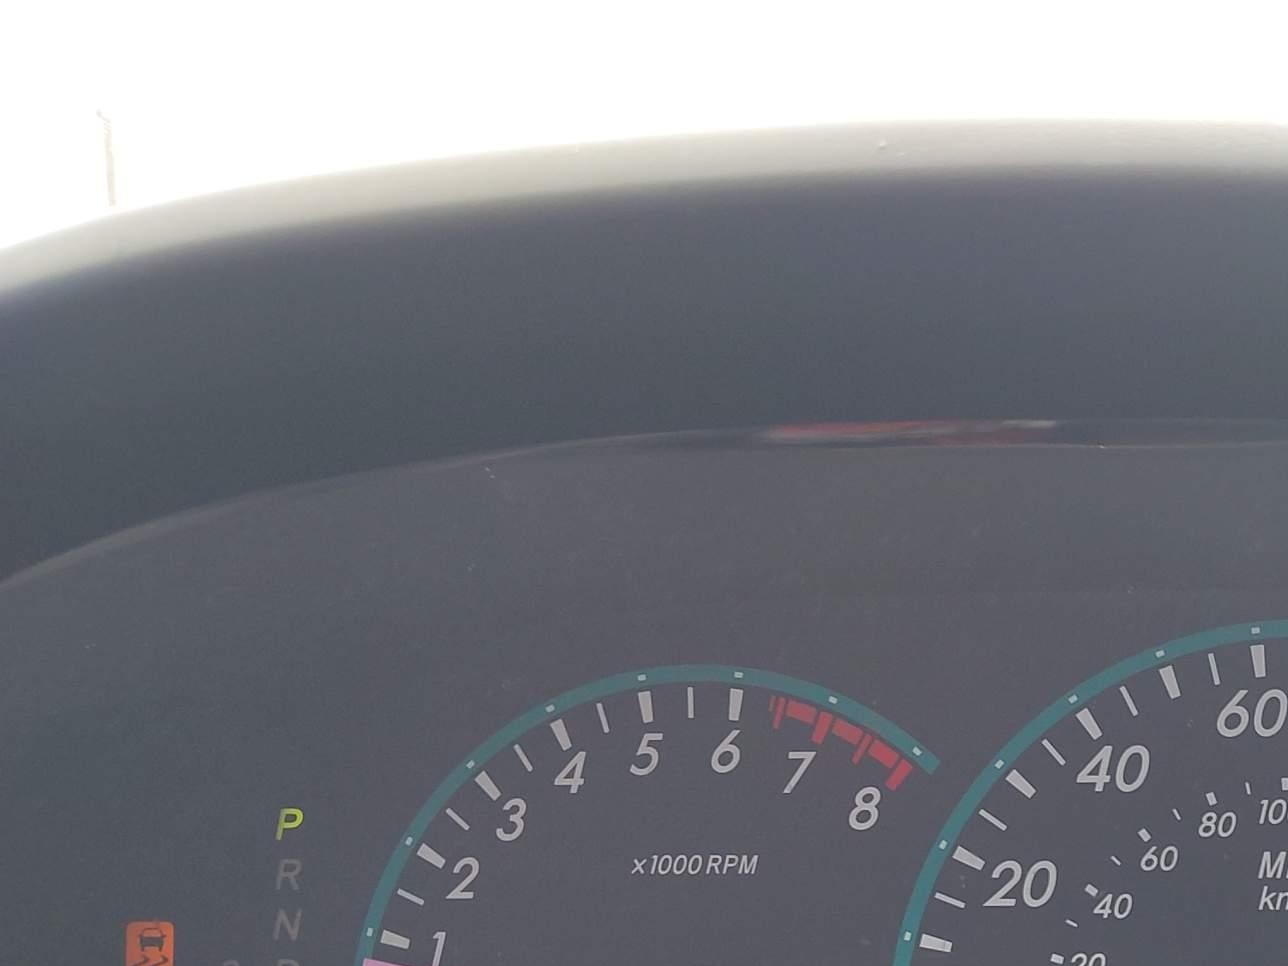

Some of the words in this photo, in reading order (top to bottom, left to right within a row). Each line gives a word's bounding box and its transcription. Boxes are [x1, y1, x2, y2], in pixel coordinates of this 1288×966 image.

[1216, 688, 1288, 738] 60
[554, 751, 586, 793] 4
[629, 732, 663, 776] 5
[710, 729, 741, 773] 6
[782, 751, 817, 794] 7
[1076, 744, 1151, 793] 40
[275, 808, 304, 841] P
[495, 797, 527, 842] 3
[848, 786, 881, 831] 8
[1198, 811, 1237, 838] 80
[276, 858, 301, 890] R
[446, 856, 480, 900] 2
[706, 855, 759, 876] RPM
[1140, 846, 1179, 872] 60
[983, 860, 1058, 908] 20
[272, 909, 302, 941] N
[1093, 894, 1133, 919] 40
